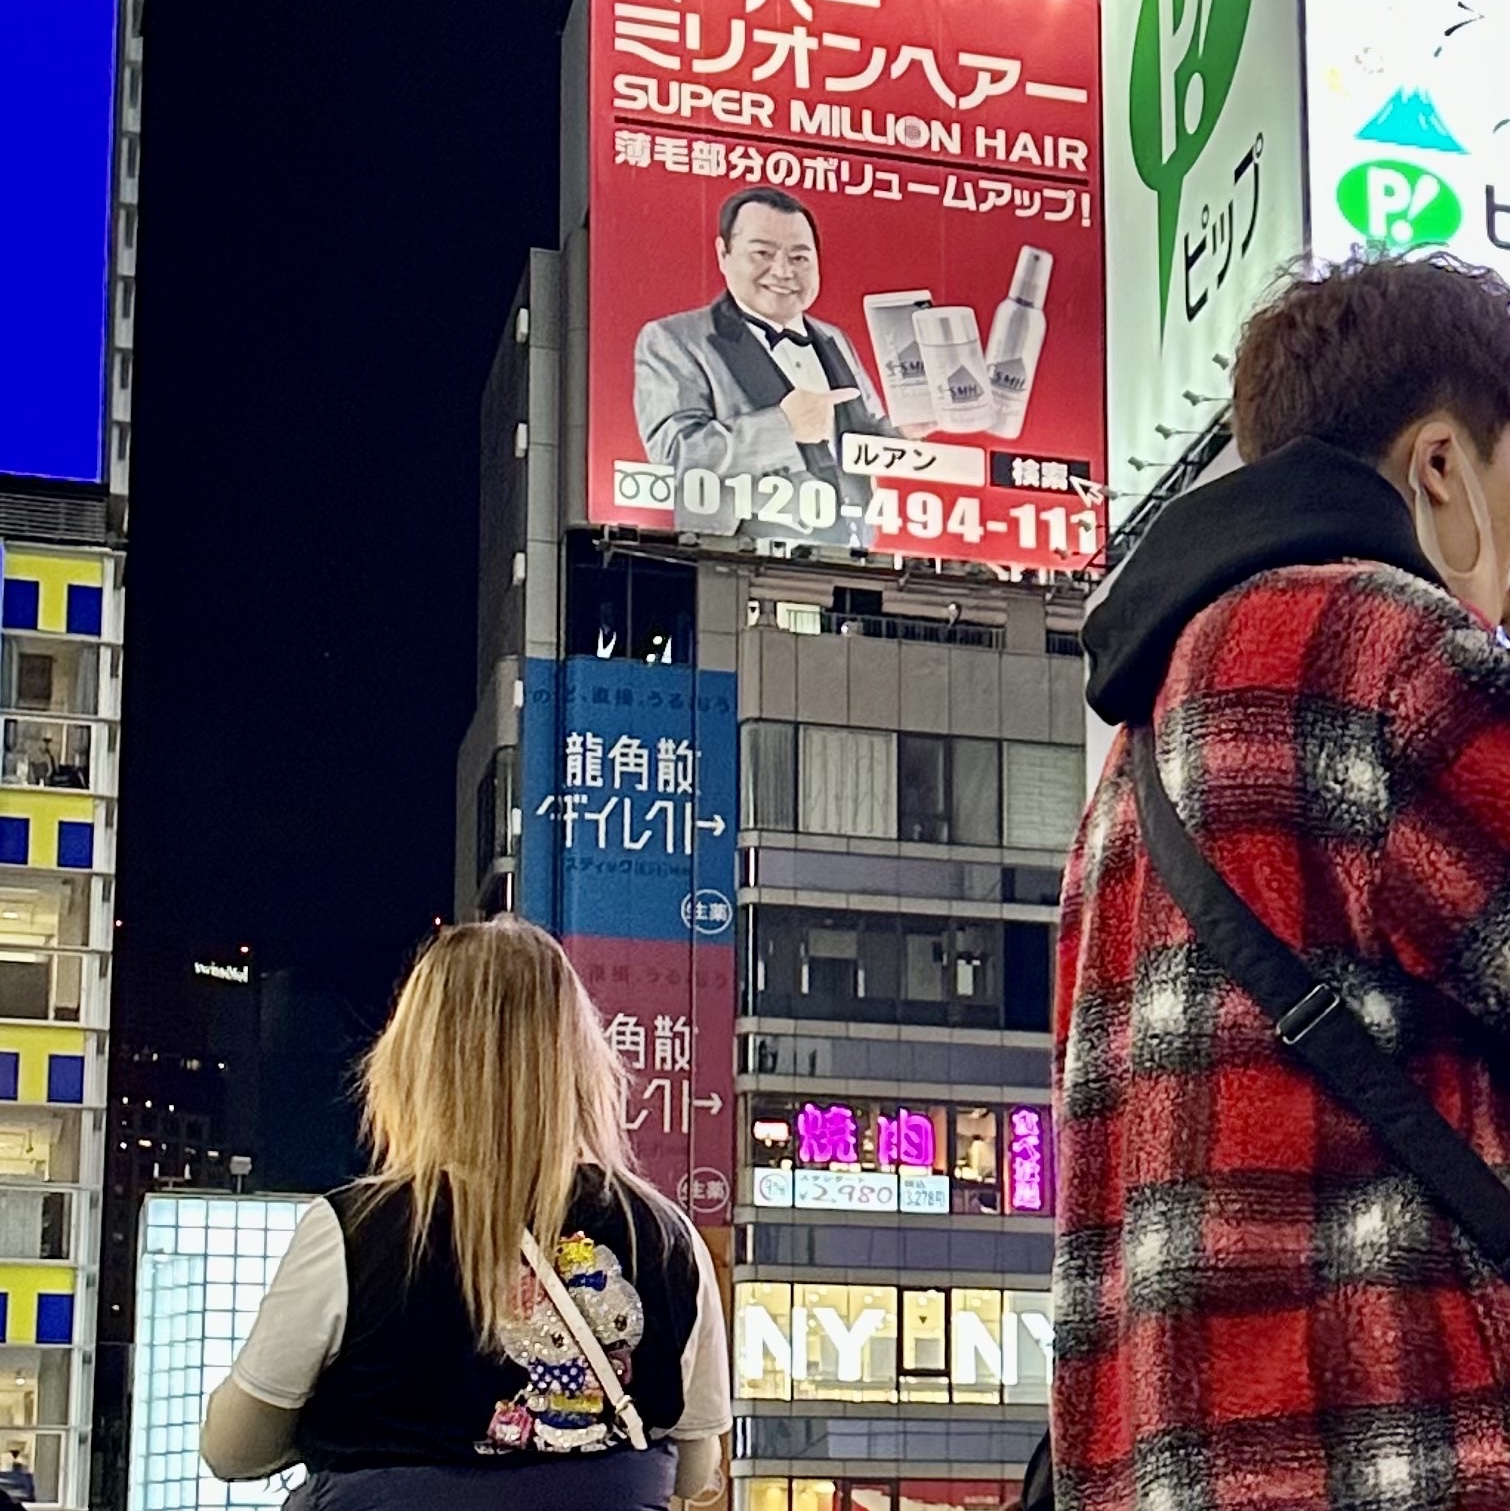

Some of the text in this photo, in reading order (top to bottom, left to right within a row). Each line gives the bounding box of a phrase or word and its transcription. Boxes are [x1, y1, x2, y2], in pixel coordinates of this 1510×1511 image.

[614, 2, 1089, 110] ミリオンヘアー
[613, 74, 1089, 172] SUPER MILLION HAIR
[1183, 131, 1264, 323] ピップ
[853, 443, 937, 472] ルアン
[682, 468, 1098, 556] 0120-494-111
[564, 731, 702, 796] 龍角散
[797, 1103, 935, 1167] 焼肉
[744, 1305, 887, 1382] NY
